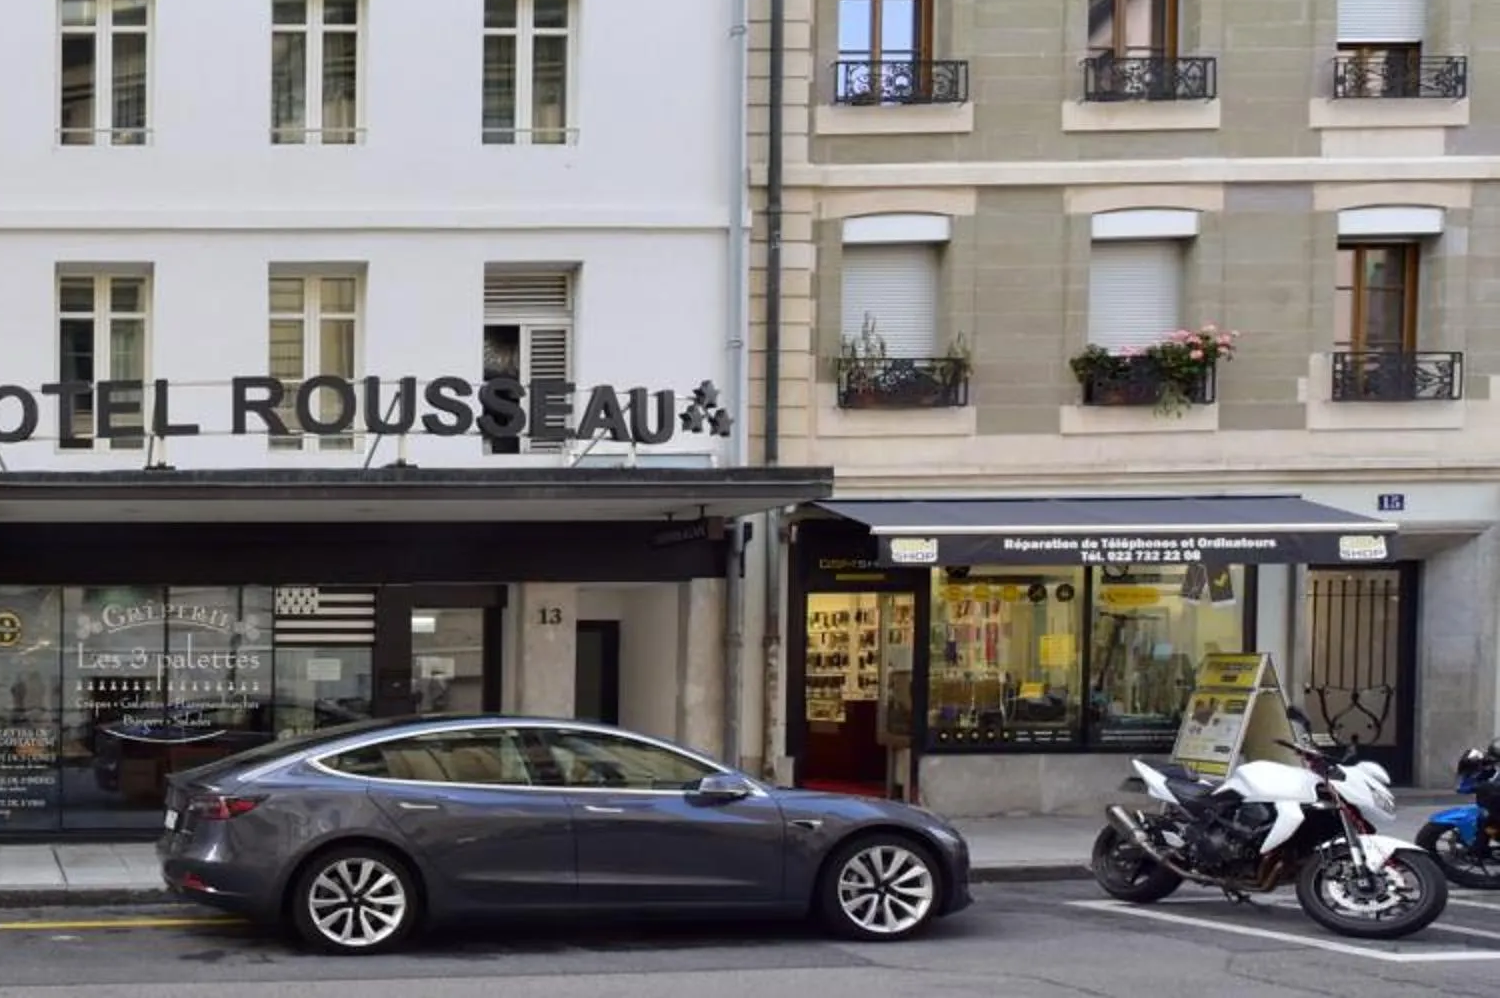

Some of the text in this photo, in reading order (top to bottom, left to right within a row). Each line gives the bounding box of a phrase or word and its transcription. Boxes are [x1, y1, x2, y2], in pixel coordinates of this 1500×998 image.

[232, 375, 676, 445] ROUSSEAU
[1383, 494, 1401, 510] 15
[1003, 538, 1079, 551] Réparation
[1081, 538, 1099, 549] de
[1100, 538, 1179, 551] Téléphones
[1181, 538, 1196, 549] et
[538, 607, 563, 626] 13
[77, 633, 261, 691] Les 3 palettes
